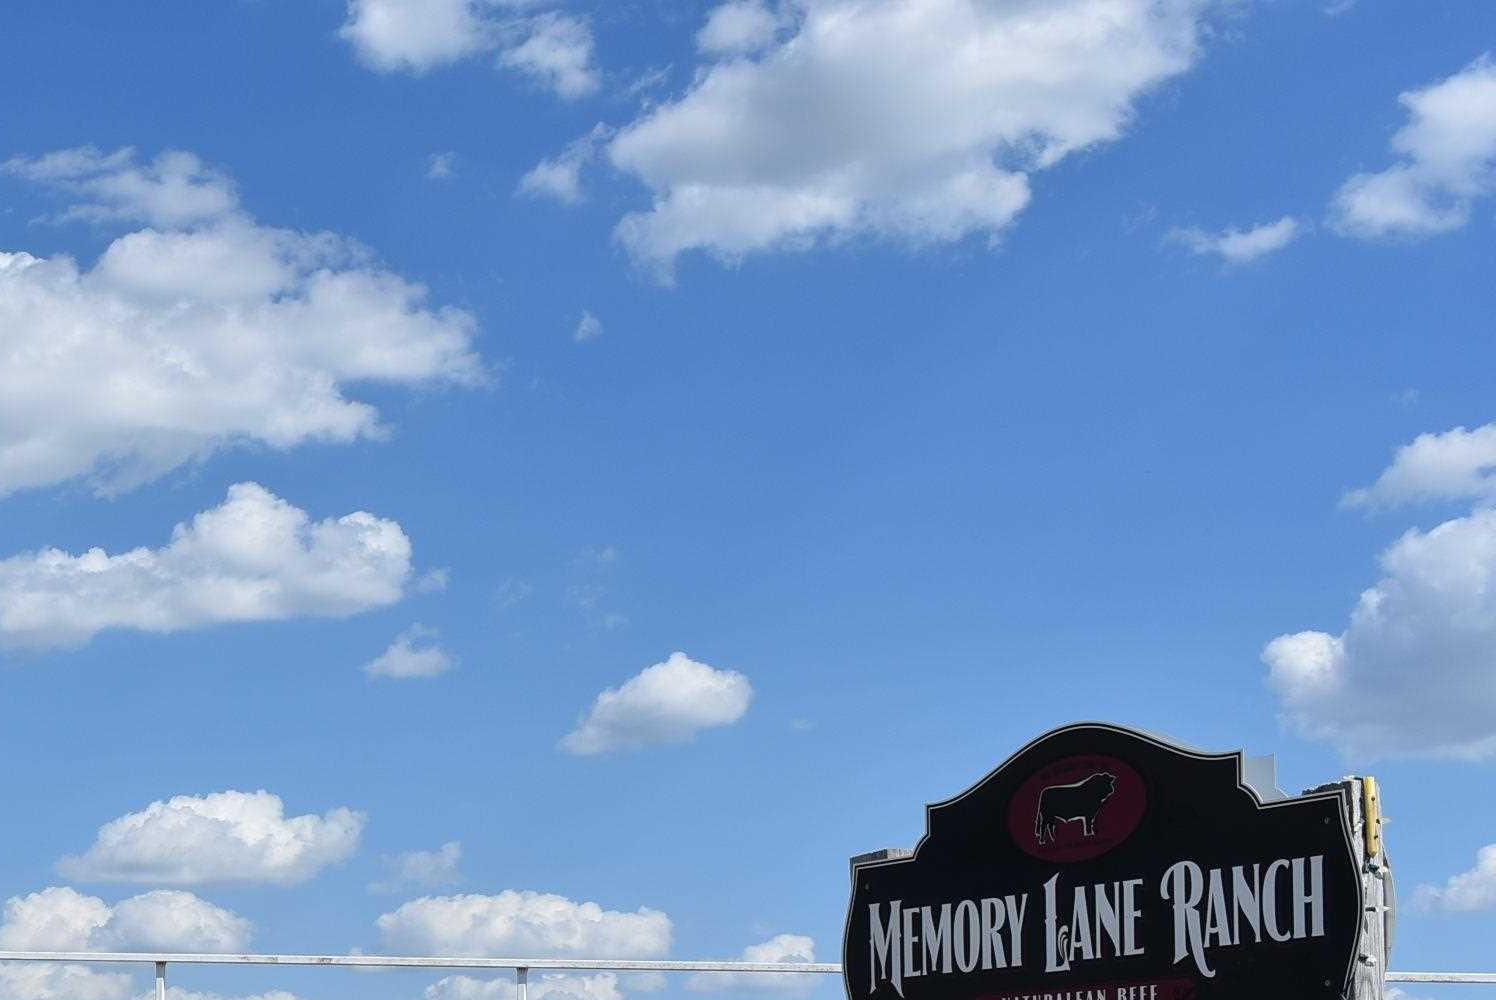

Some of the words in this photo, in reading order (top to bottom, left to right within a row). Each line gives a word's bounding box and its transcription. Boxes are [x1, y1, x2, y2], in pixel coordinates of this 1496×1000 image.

[868, 893, 1028, 998] MEMORY
[1043, 871, 1145, 974] LANE
[1160, 854, 1327, 979] RANCH
